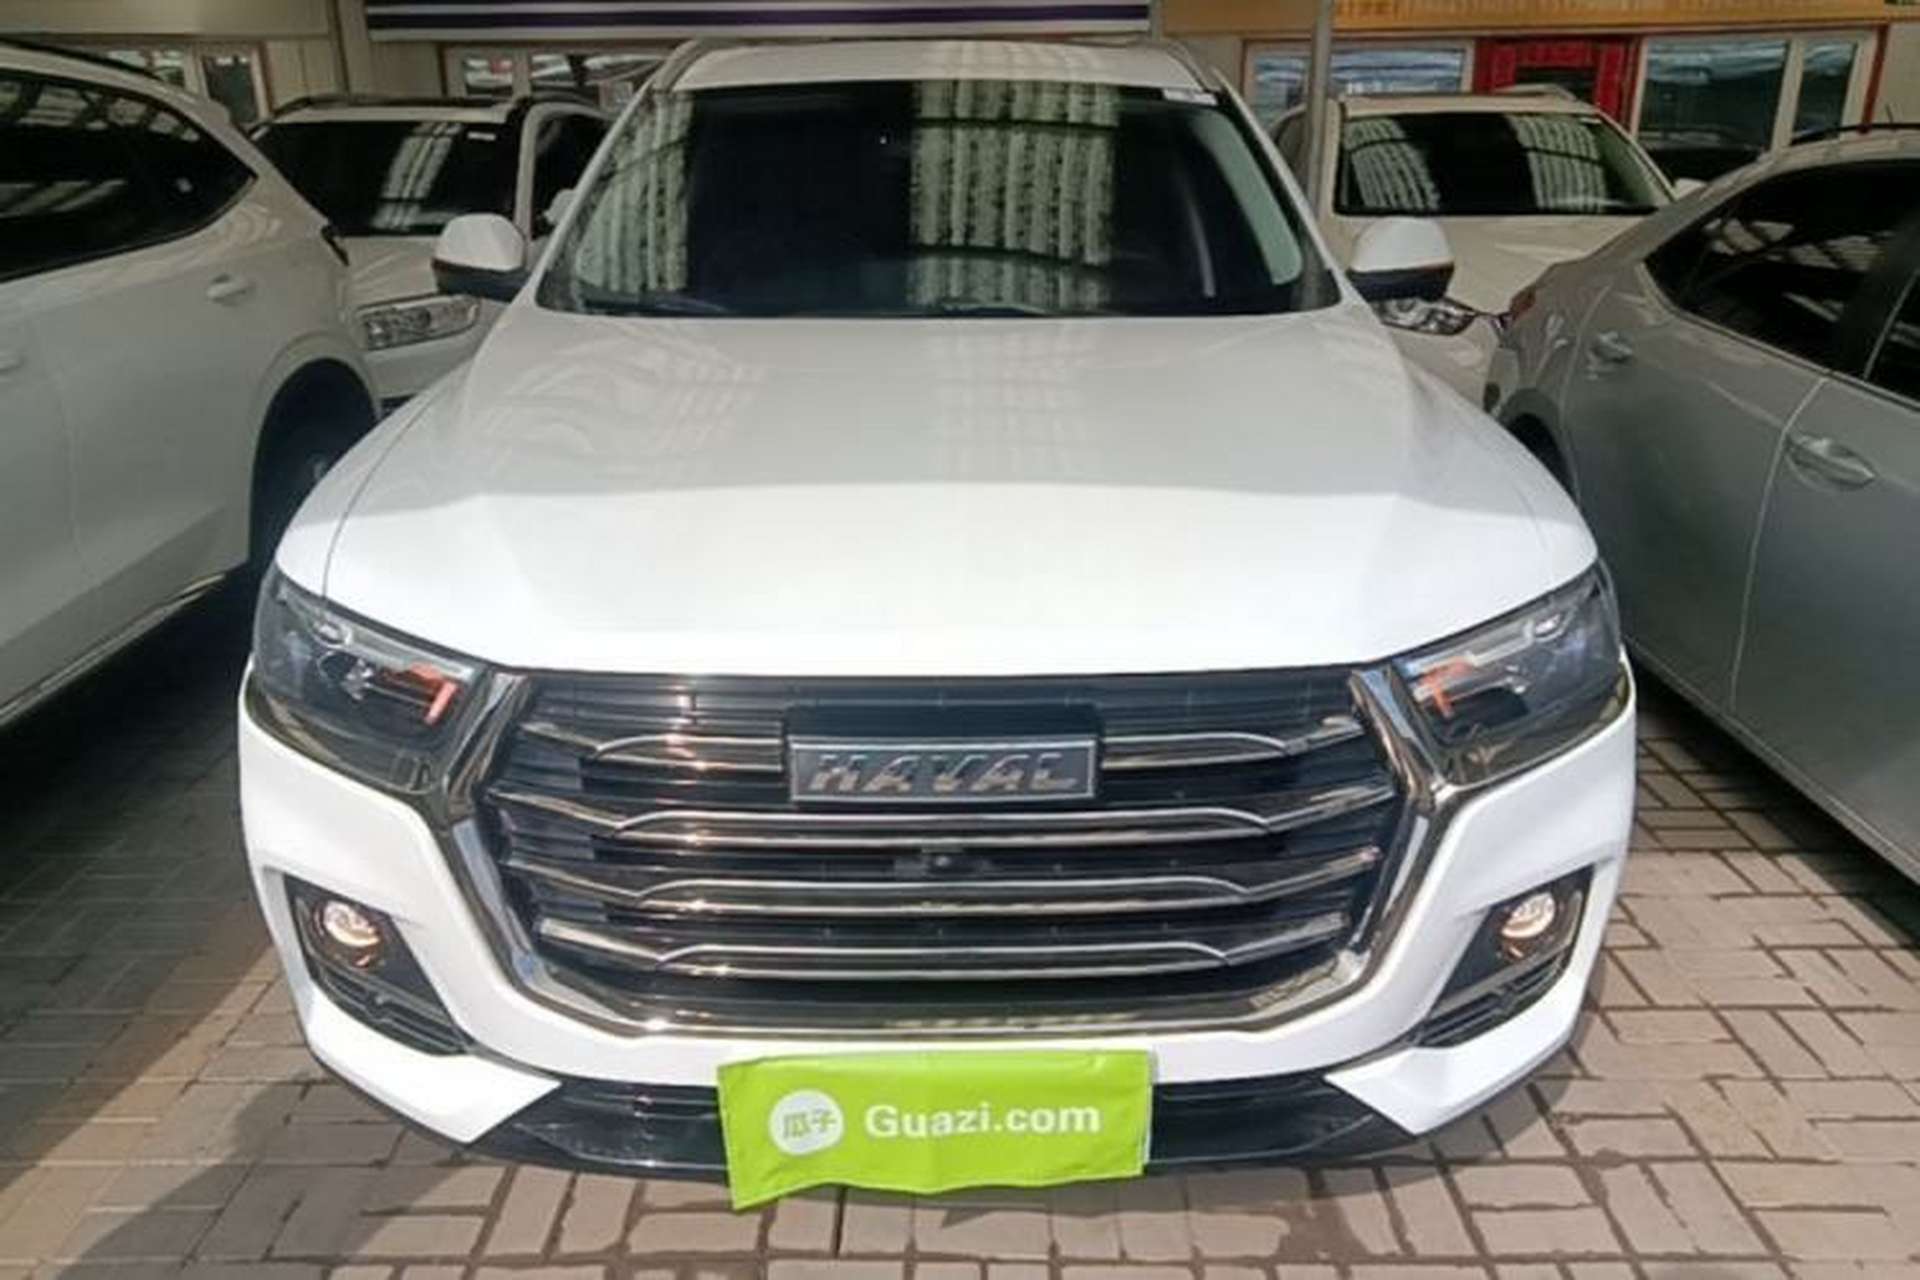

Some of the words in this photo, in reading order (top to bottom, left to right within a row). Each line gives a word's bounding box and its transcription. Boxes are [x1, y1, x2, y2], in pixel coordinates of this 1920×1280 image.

[808, 752, 1077, 792] HAVAL
[782, 1108, 837, 1139] 瓜子
[865, 1101, 1101, 1139] Guazi.com
